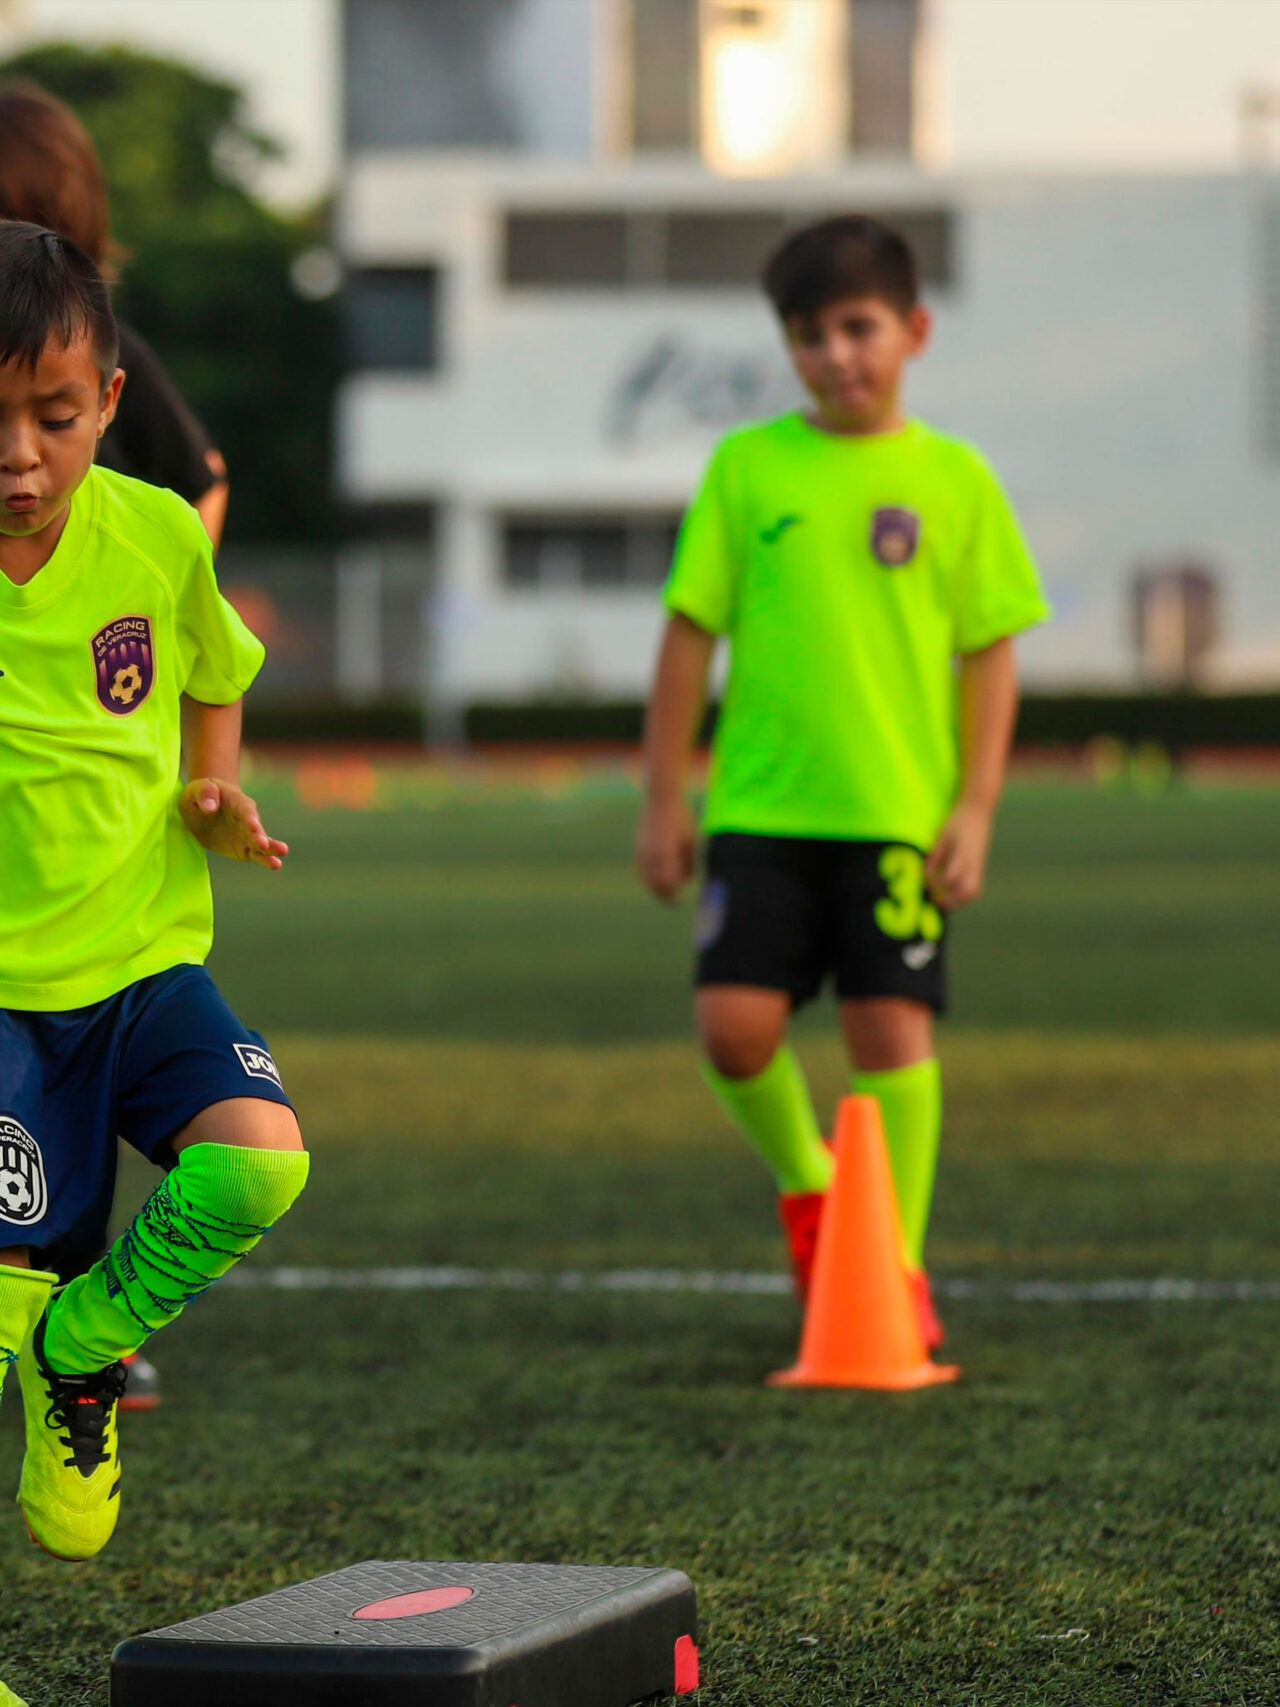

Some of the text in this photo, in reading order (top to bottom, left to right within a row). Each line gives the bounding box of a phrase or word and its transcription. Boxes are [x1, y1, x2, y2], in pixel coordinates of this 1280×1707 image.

[95, 620, 146, 648] RACING
[97, 631, 147, 657] DE VERACRUZ
